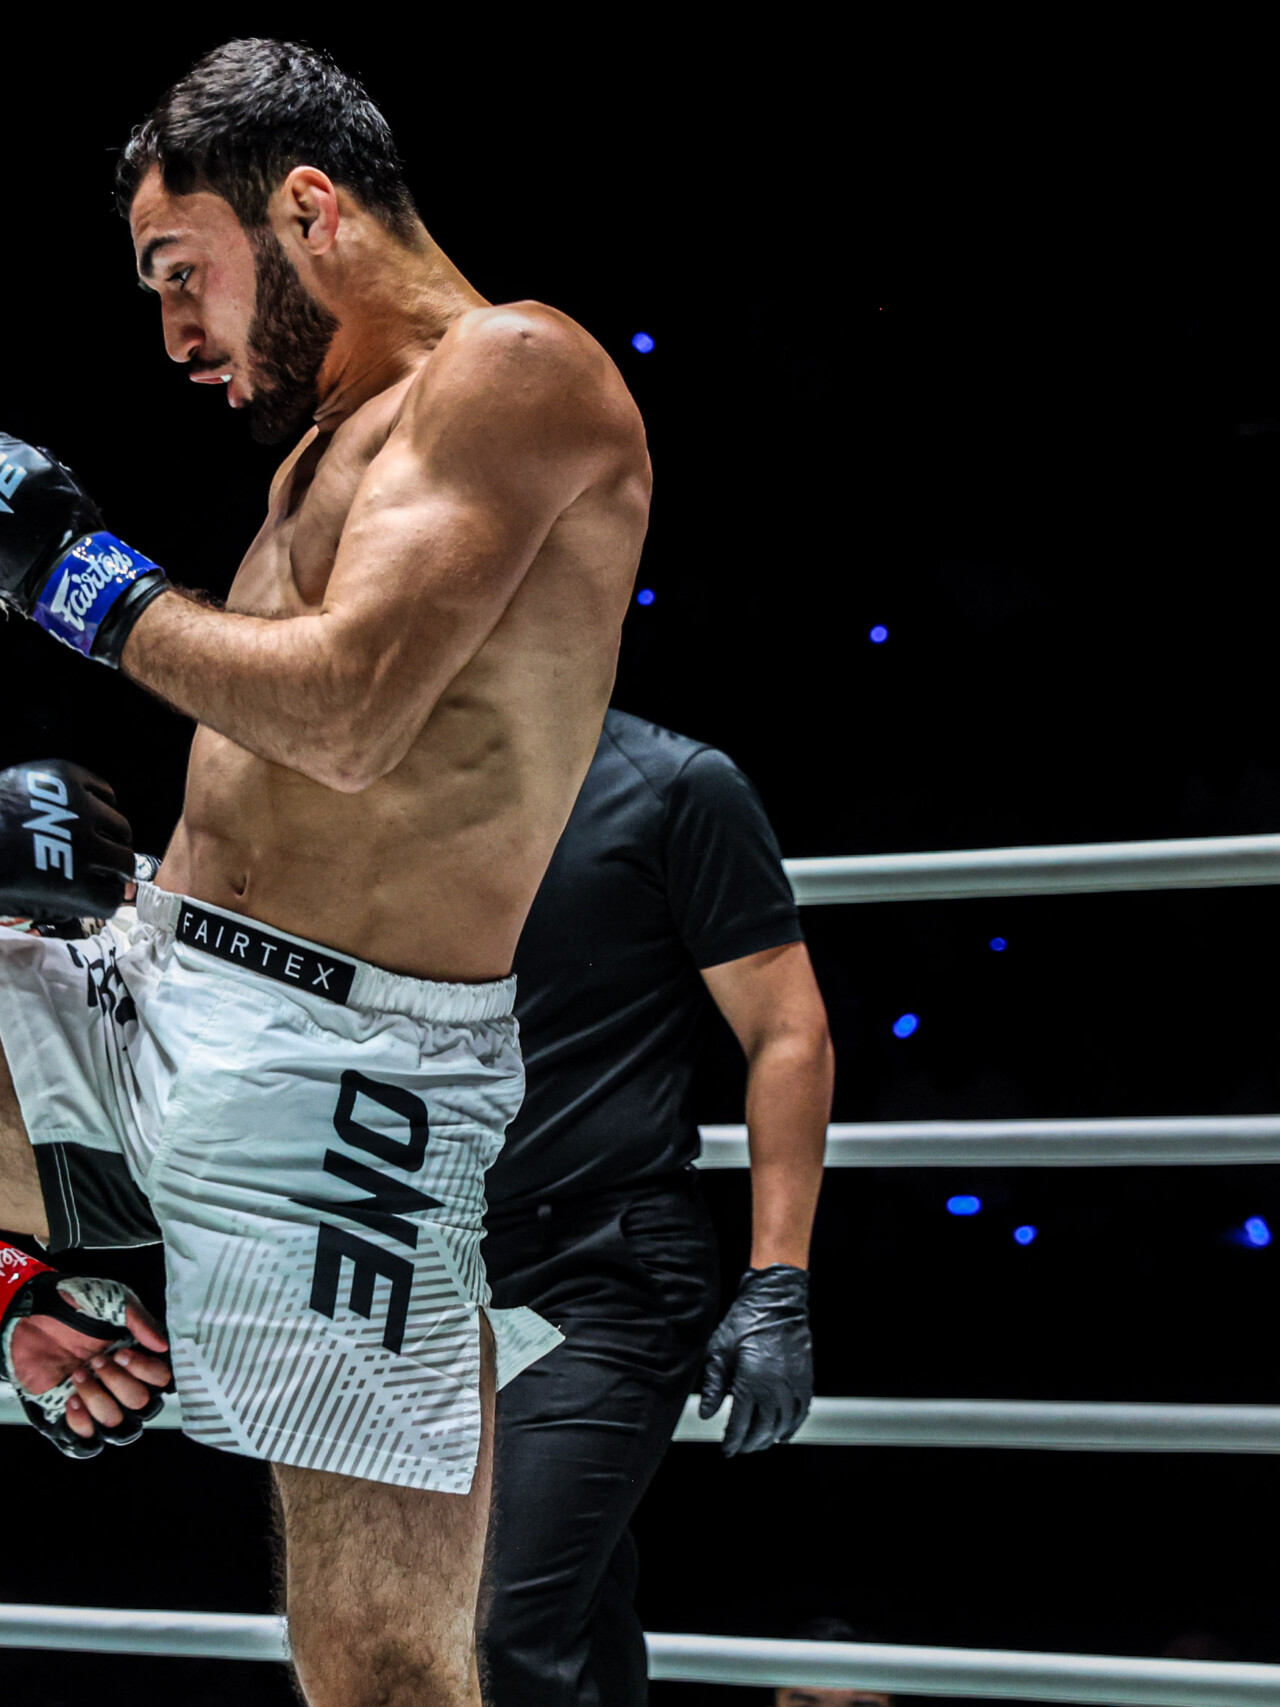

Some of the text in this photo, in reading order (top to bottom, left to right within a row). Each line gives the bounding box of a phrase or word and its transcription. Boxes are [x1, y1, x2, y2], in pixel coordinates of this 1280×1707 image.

[50, 545, 134, 631] Fairtex
[22, 771, 79, 880] ONE
[182, 911, 335, 991] FAIRTEX
[287, 1068, 446, 1356] ONE
